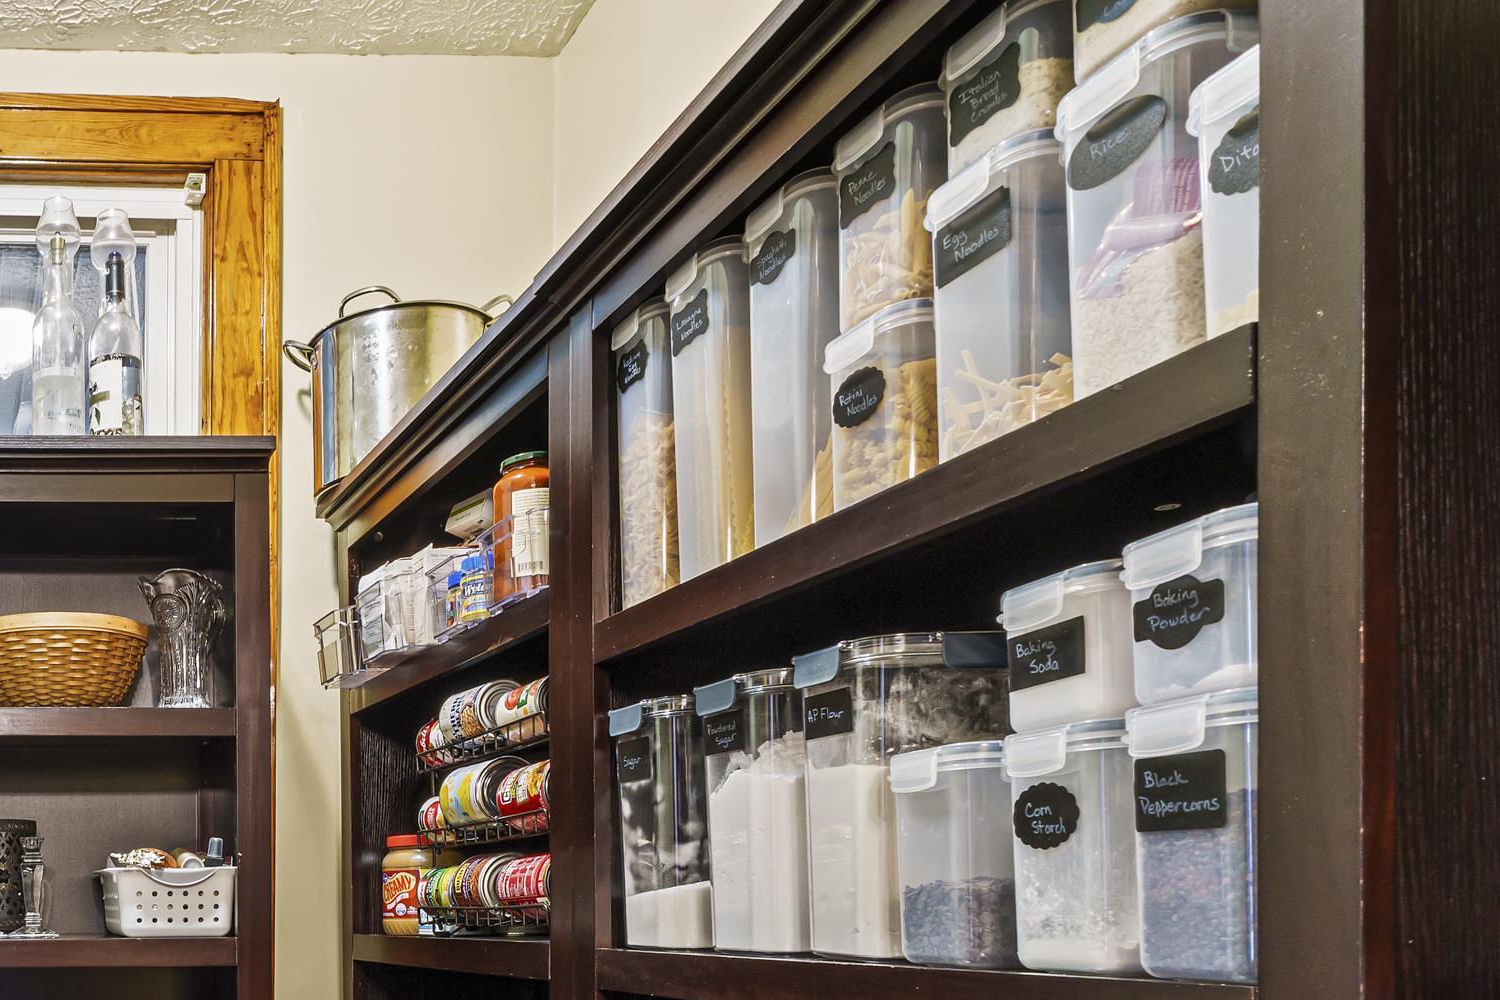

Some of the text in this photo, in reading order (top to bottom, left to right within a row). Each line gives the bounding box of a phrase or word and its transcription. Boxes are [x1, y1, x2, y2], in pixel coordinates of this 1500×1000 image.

[958, 70, 1000, 104] Italian
[1090, 129, 1131, 160] Rice
[848, 170, 878, 192] Penne
[854, 177, 886, 205] Noodles
[943, 231, 967, 250] Egg
[955, 227, 999, 262] Noodles
[759, 256, 786, 279] Noodles
[676, 308, 701, 330] Lasagna
[680, 320, 703, 341] Noodles
[839, 389, 863, 407] Rotini
[847, 394, 878, 416] Noodles
[1153, 589, 1198, 608] Baking
[1147, 607, 1210, 632] Powder
[1016, 639, 1056, 658] Baking
[1030, 654, 1059, 674] Soda
[808, 707, 844, 723] AP Flour
[707, 720, 736, 735] Powdered
[715, 733, 737, 748] Sugar
[623, 755, 641, 769] Sugar
[1144, 771, 1188, 788] Black
[1024, 802, 1052, 818] Corn
[1139, 796, 1220, 817] Peppercorns
[1031, 818, 1066, 834] Starch
